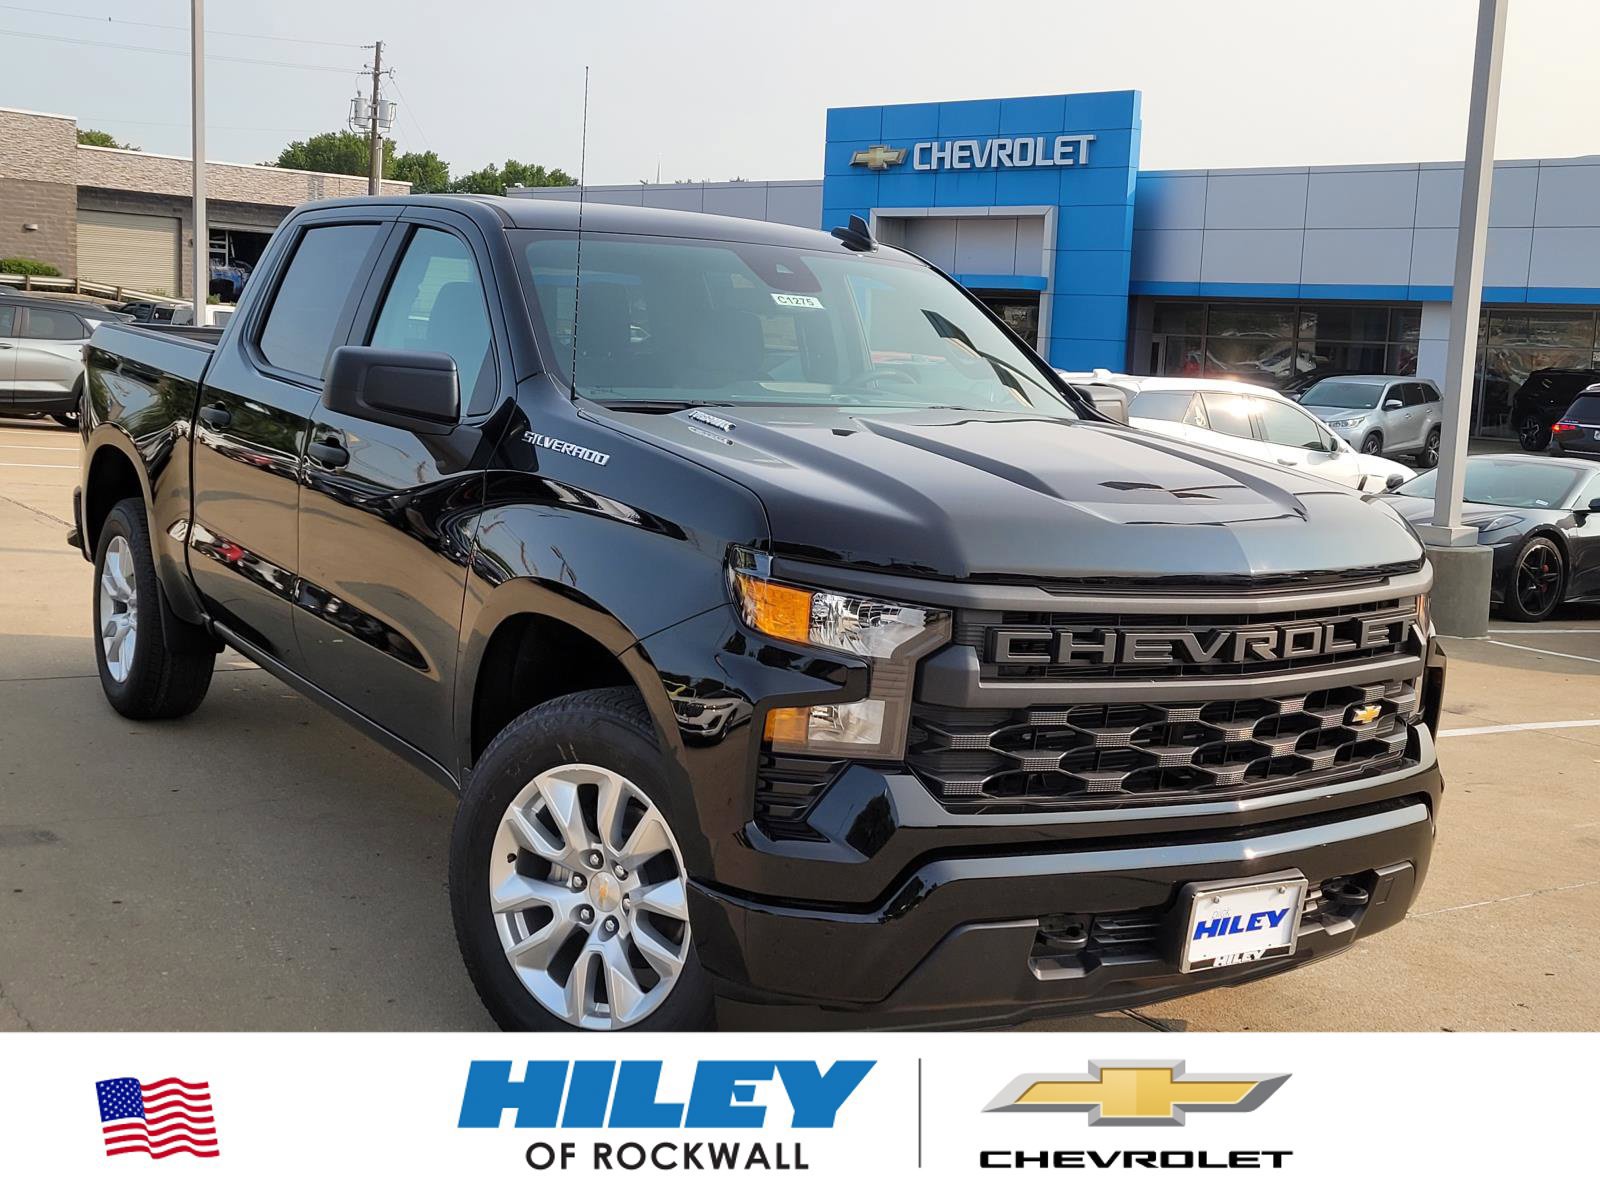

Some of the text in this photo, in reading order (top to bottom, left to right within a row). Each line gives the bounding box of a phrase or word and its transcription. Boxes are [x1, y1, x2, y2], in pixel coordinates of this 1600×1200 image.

[913, 134, 1096, 170] CHEVROLET
[777, 295, 815, 306] C1275
[521, 430, 610, 466] SILVERADO
[1192, 907, 1290, 941] HILEY
[1213, 949, 1266, 967] HILEY
